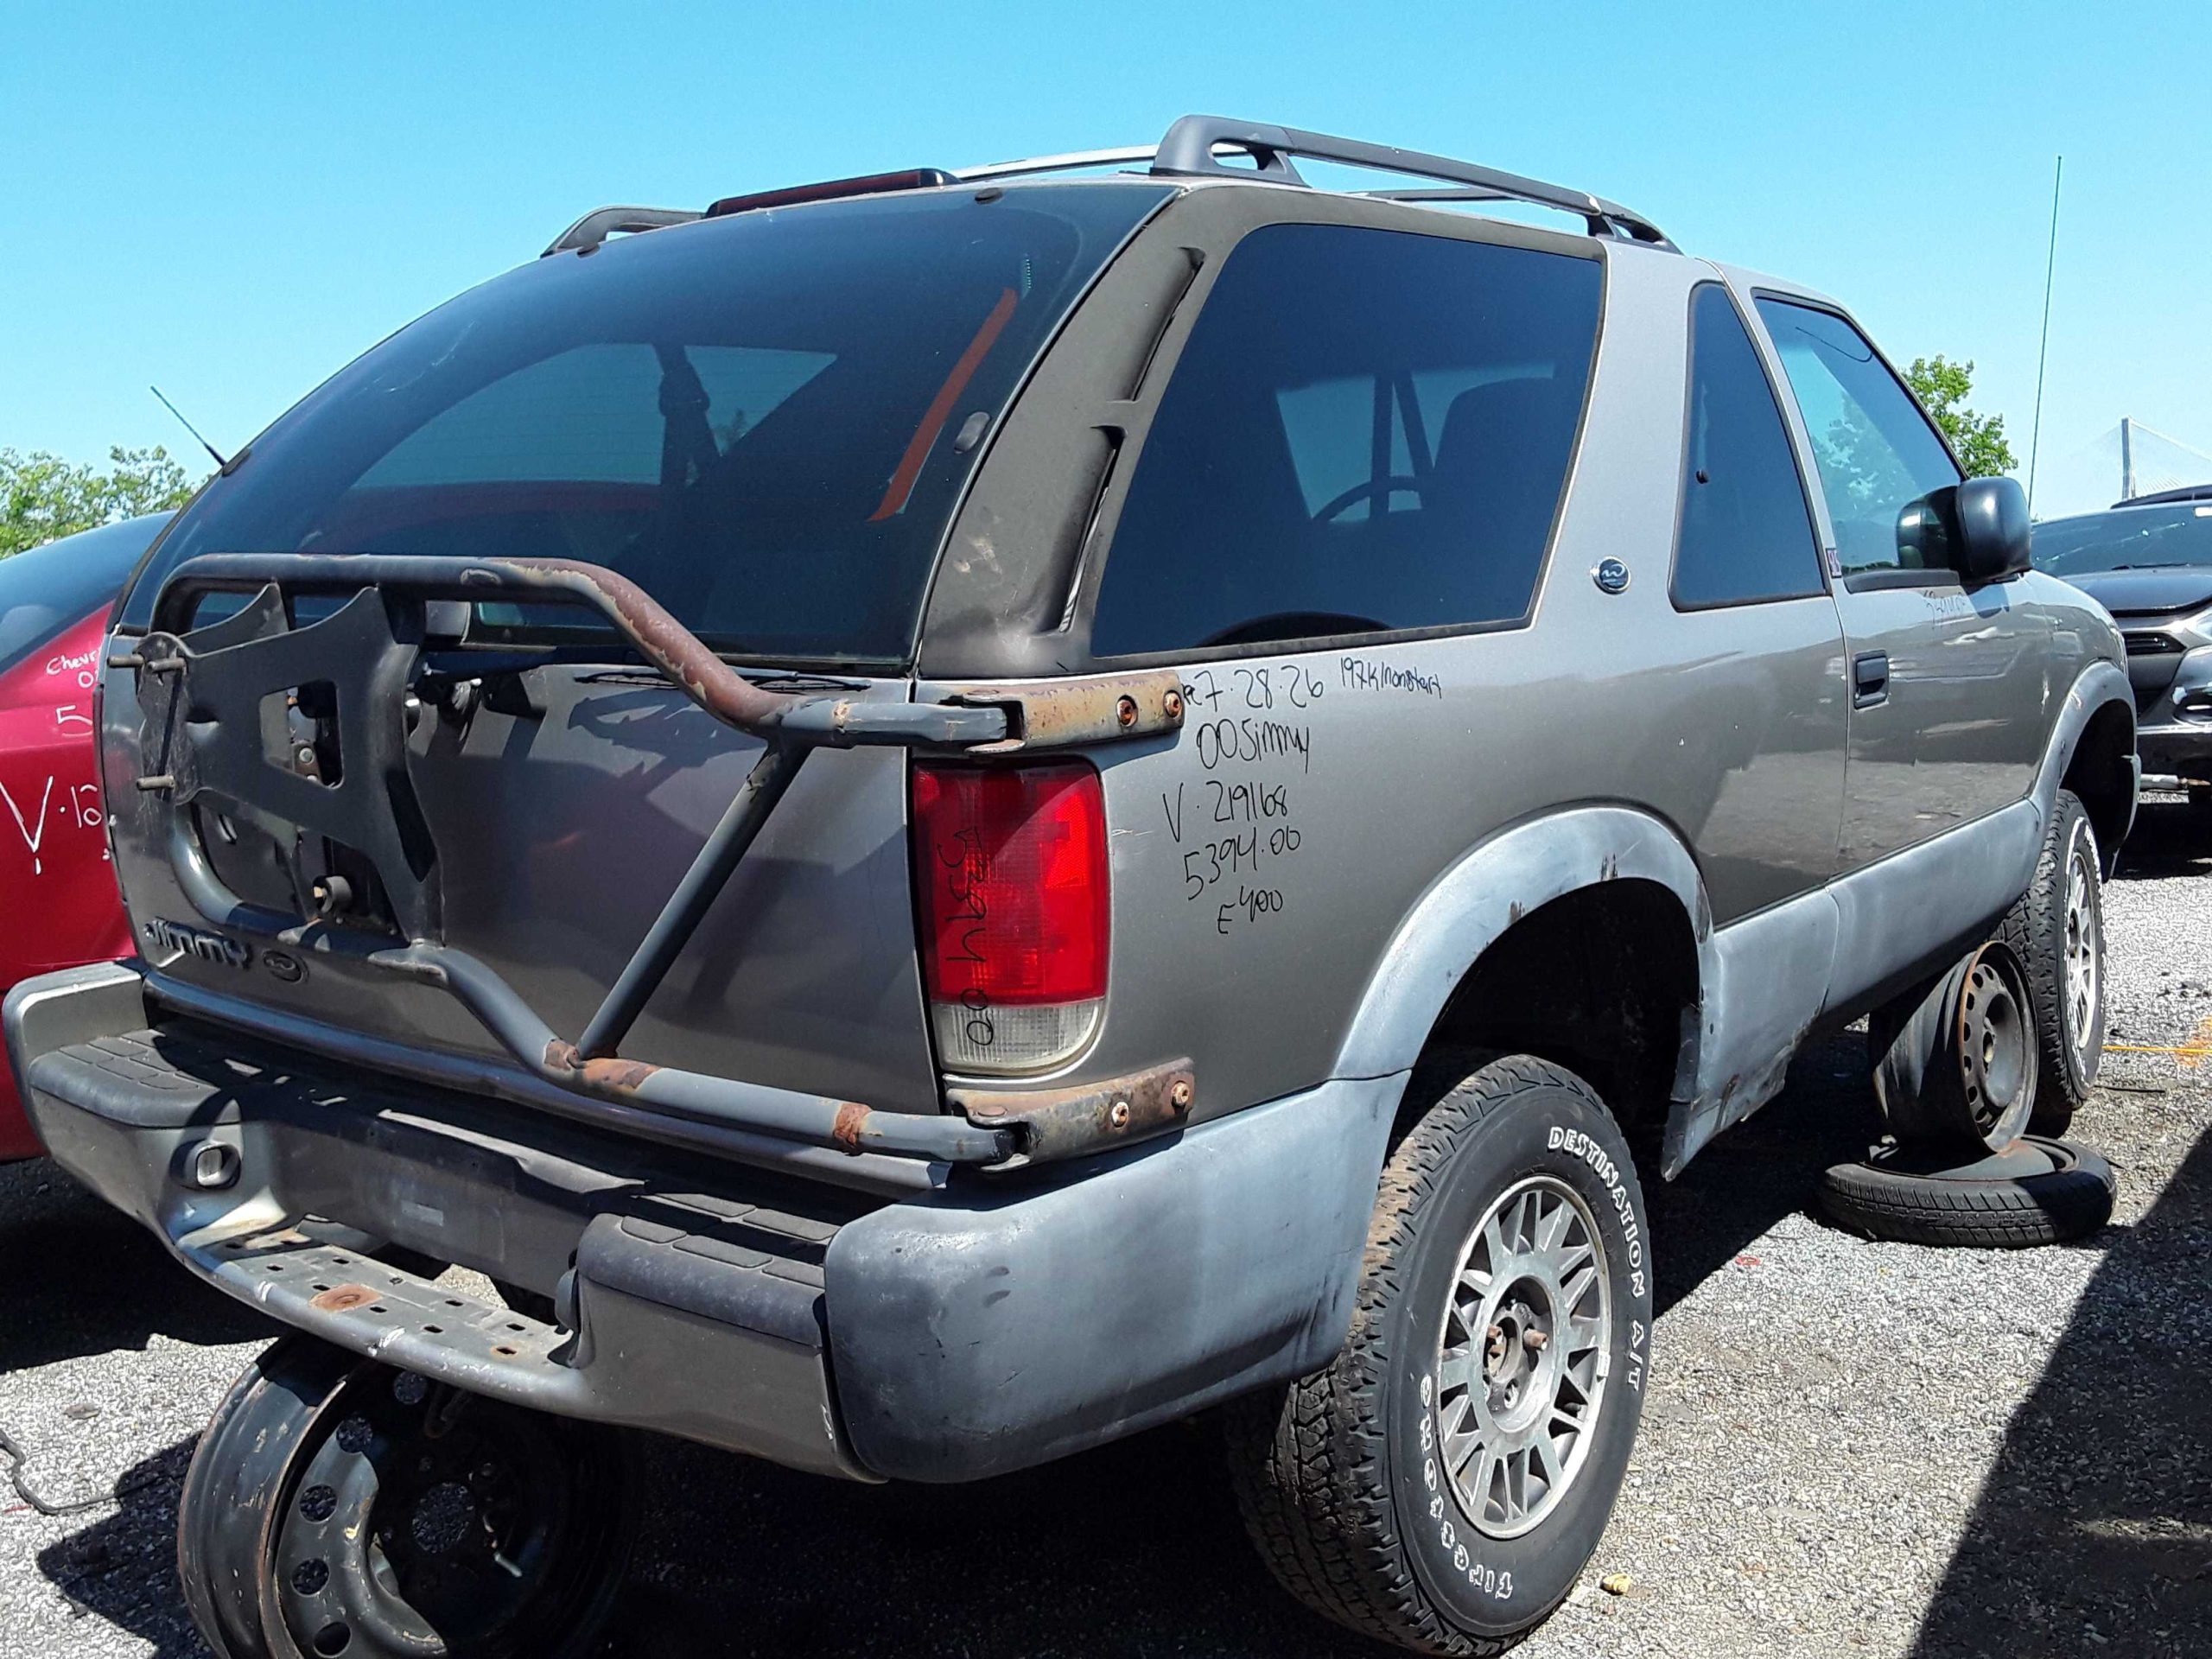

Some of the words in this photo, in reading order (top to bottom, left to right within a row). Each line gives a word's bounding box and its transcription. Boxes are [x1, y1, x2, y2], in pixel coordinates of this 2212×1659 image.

[47, 650, 98, 675] Chevr
[78, 670, 99, 688] 0
[1547, 1126, 1645, 1298] DESTINATION
[1627, 1319, 1645, 1391] A/T
